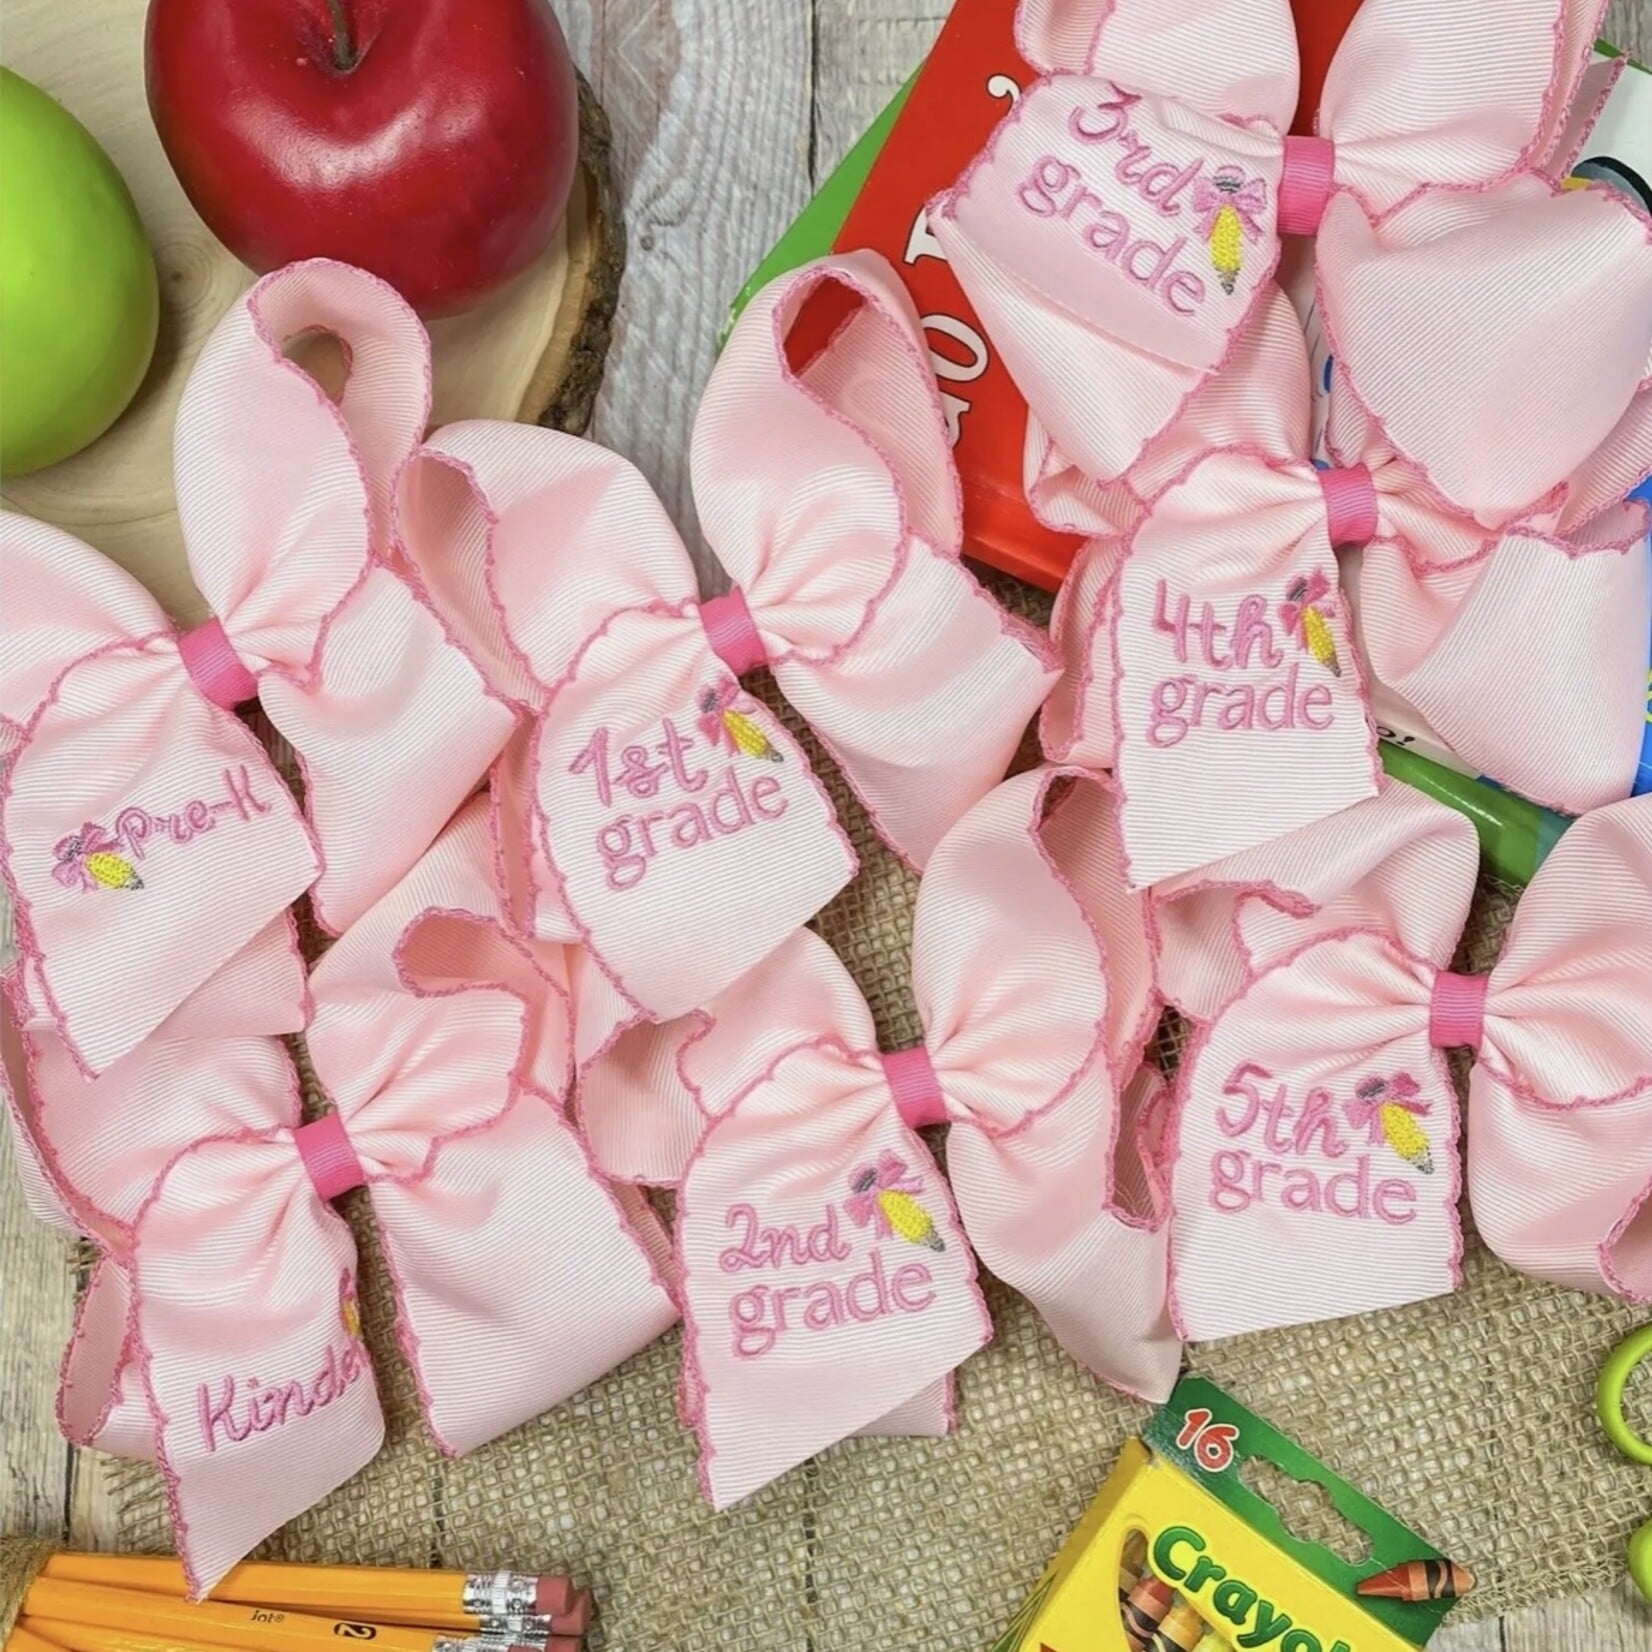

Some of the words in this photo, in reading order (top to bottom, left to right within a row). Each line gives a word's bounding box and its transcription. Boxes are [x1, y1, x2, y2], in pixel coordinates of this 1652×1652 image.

[1068, 81, 1205, 217] 3rd
[1018, 154, 1206, 316] grade
[1151, 578, 1285, 671] 4th
[1147, 662, 1335, 749] grade
[568, 717, 709, 808] 1st
[115, 764, 271, 861] Pre-K
[596, 764, 789, 891] grade
[1215, 1060, 1350, 1158] 5th
[1208, 1150, 1417, 1225] grade
[719, 1203, 852, 1273] 2nd
[728, 1247, 937, 1360] grade
[1176, 1407, 1240, 1473] 16
